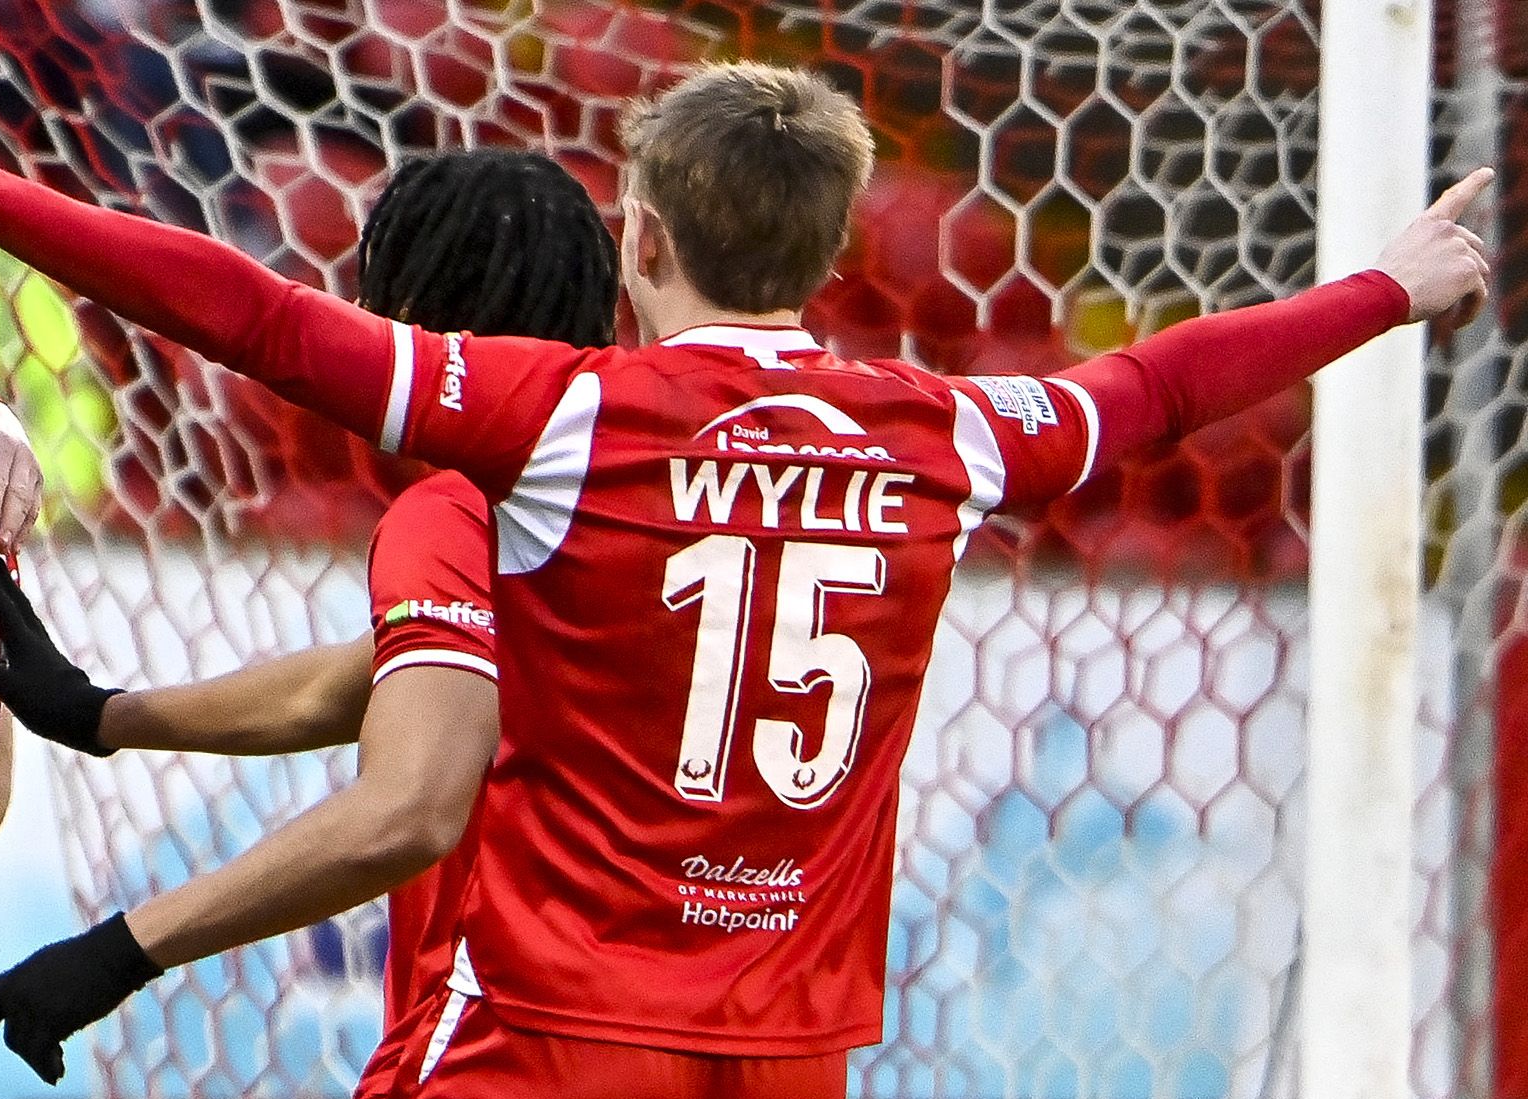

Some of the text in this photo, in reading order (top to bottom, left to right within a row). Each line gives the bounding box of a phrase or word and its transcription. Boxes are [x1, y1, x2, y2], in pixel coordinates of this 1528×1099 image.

[732, 424, 769, 440] David
[669, 457, 915, 534] WYLIE
[661, 533, 887, 810] 15
[681, 854, 804, 887] Dalzells
[678, 884, 807, 903] OF MARKETHILL
[681, 901, 799, 933] Hotpoint
